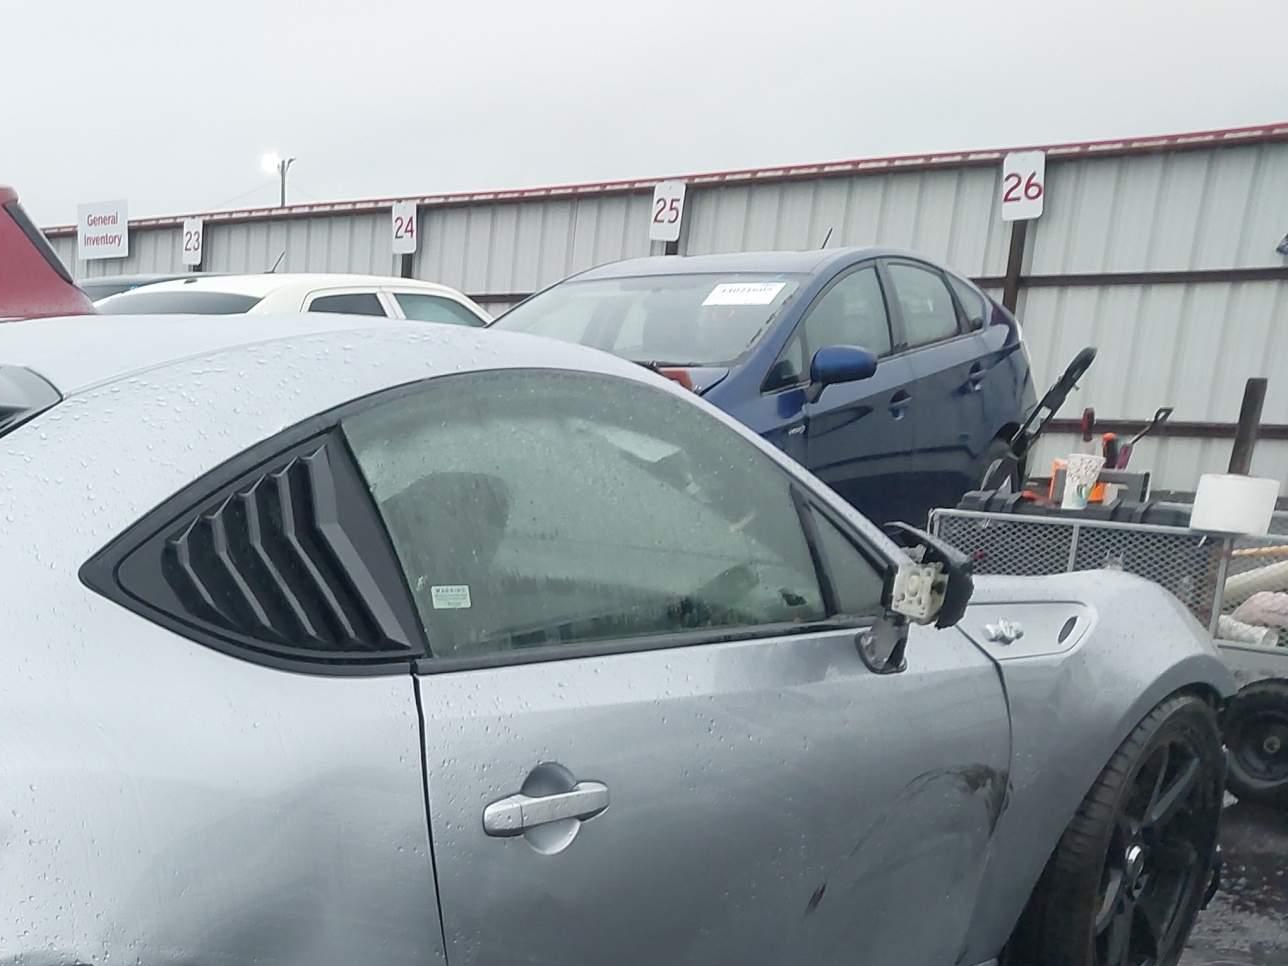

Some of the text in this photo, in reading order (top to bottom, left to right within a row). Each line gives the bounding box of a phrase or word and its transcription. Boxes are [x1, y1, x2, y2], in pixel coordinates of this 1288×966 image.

[1003, 171, 1043, 202] 26
[87, 211, 118, 227] General
[653, 197, 680, 223] 25
[394, 216, 414, 239] 24
[83, 233, 122, 248] Inventory
[184, 231, 201, 251] 23
